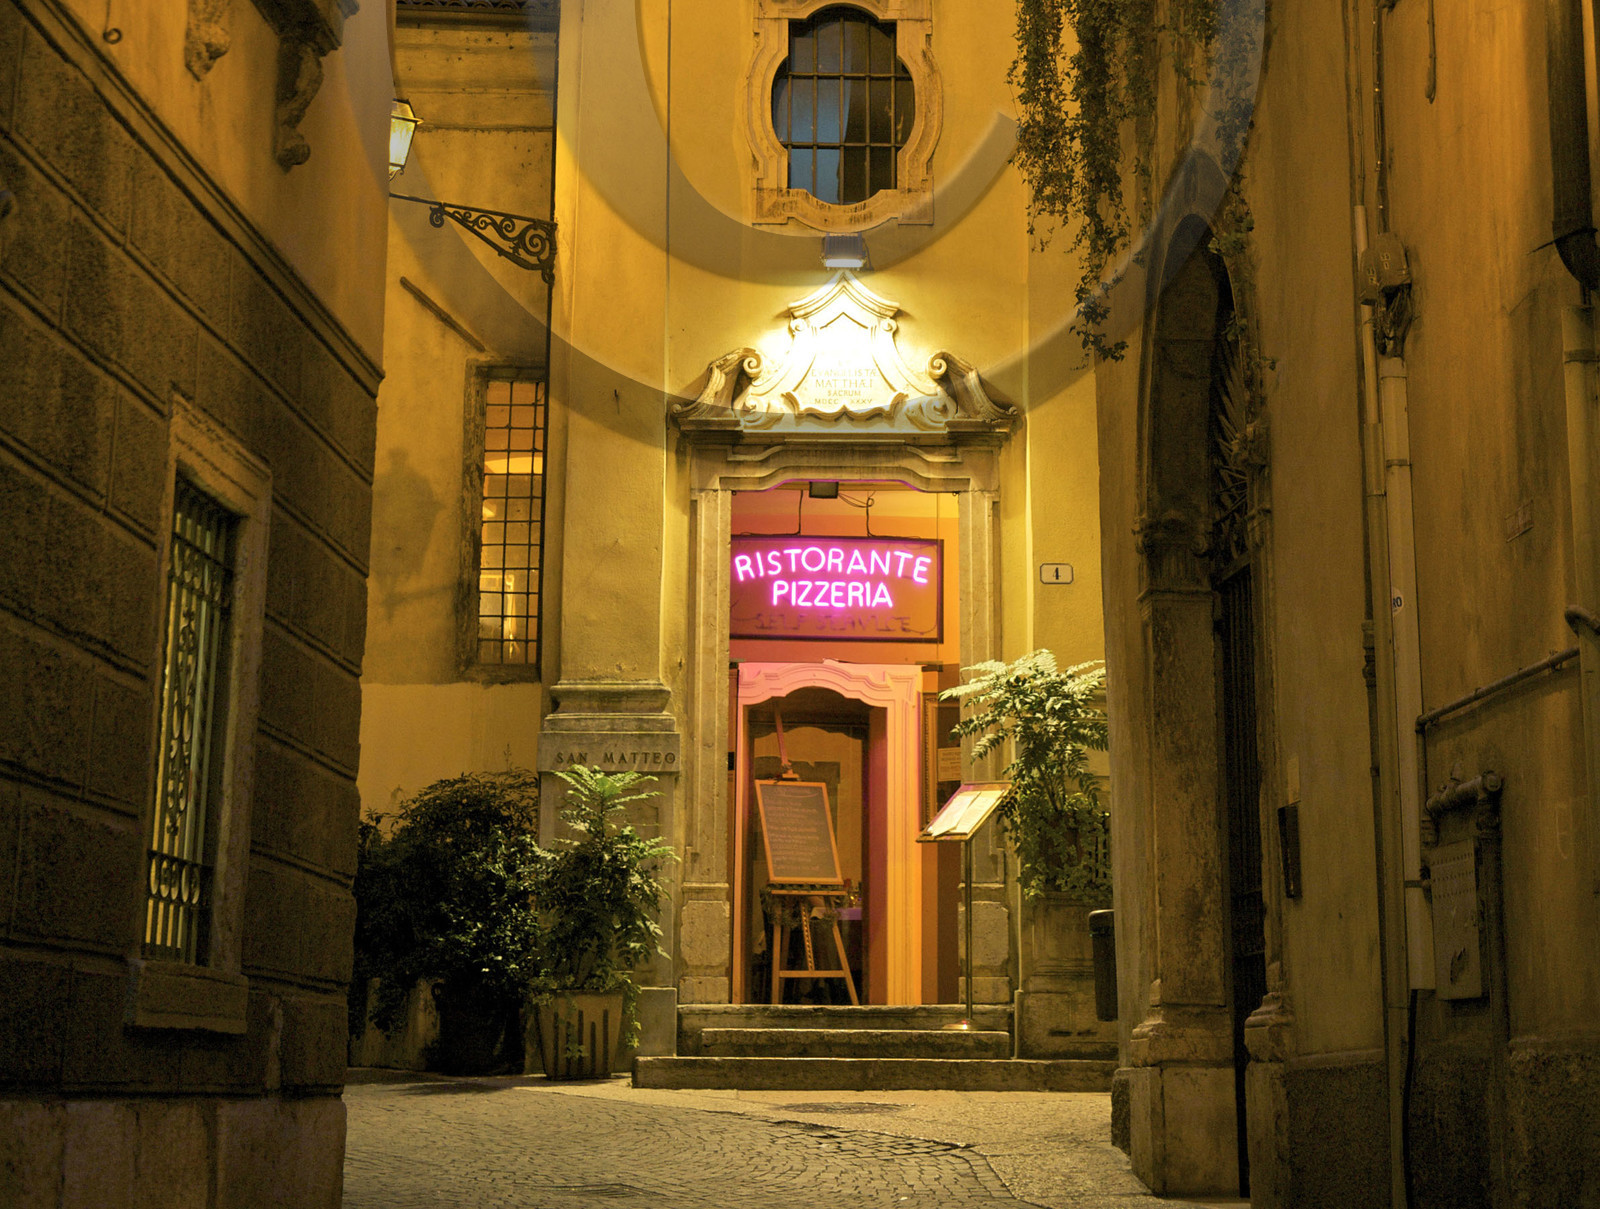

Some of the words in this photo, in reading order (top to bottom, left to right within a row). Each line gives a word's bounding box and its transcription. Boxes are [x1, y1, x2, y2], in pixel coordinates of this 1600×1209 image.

[734, 546, 932, 584] RISTORANTE
[1053, 567, 1061, 580] 4
[772, 580, 894, 608] PIZZERIA
[556, 752, 588, 764] SAN
[603, 752, 676, 764] MATTEO
